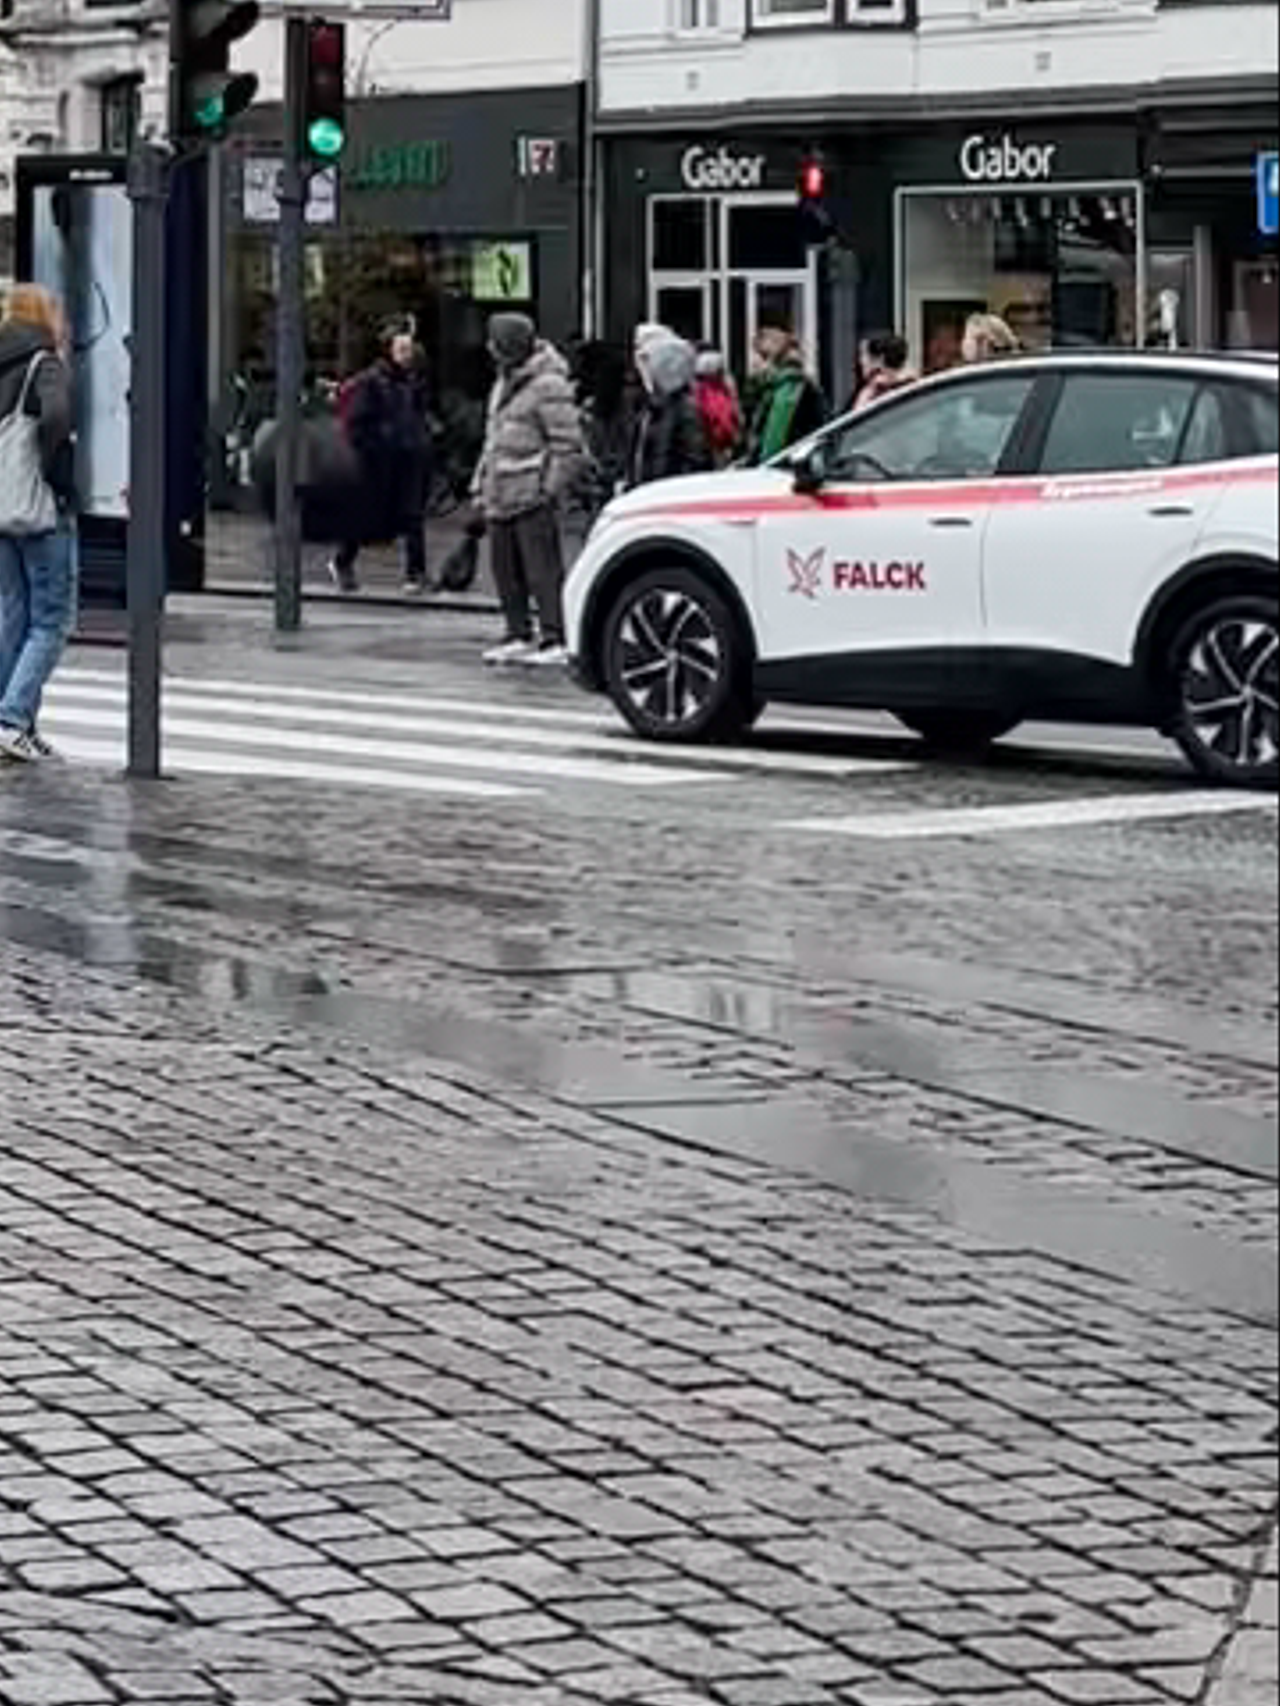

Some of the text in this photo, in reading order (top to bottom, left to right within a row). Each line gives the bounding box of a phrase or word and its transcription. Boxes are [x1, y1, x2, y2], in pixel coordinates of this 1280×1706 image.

[680, 144, 766, 188] Gabor
[959, 133, 1056, 181] Gabor
[832, 561, 927, 591] FALCK
